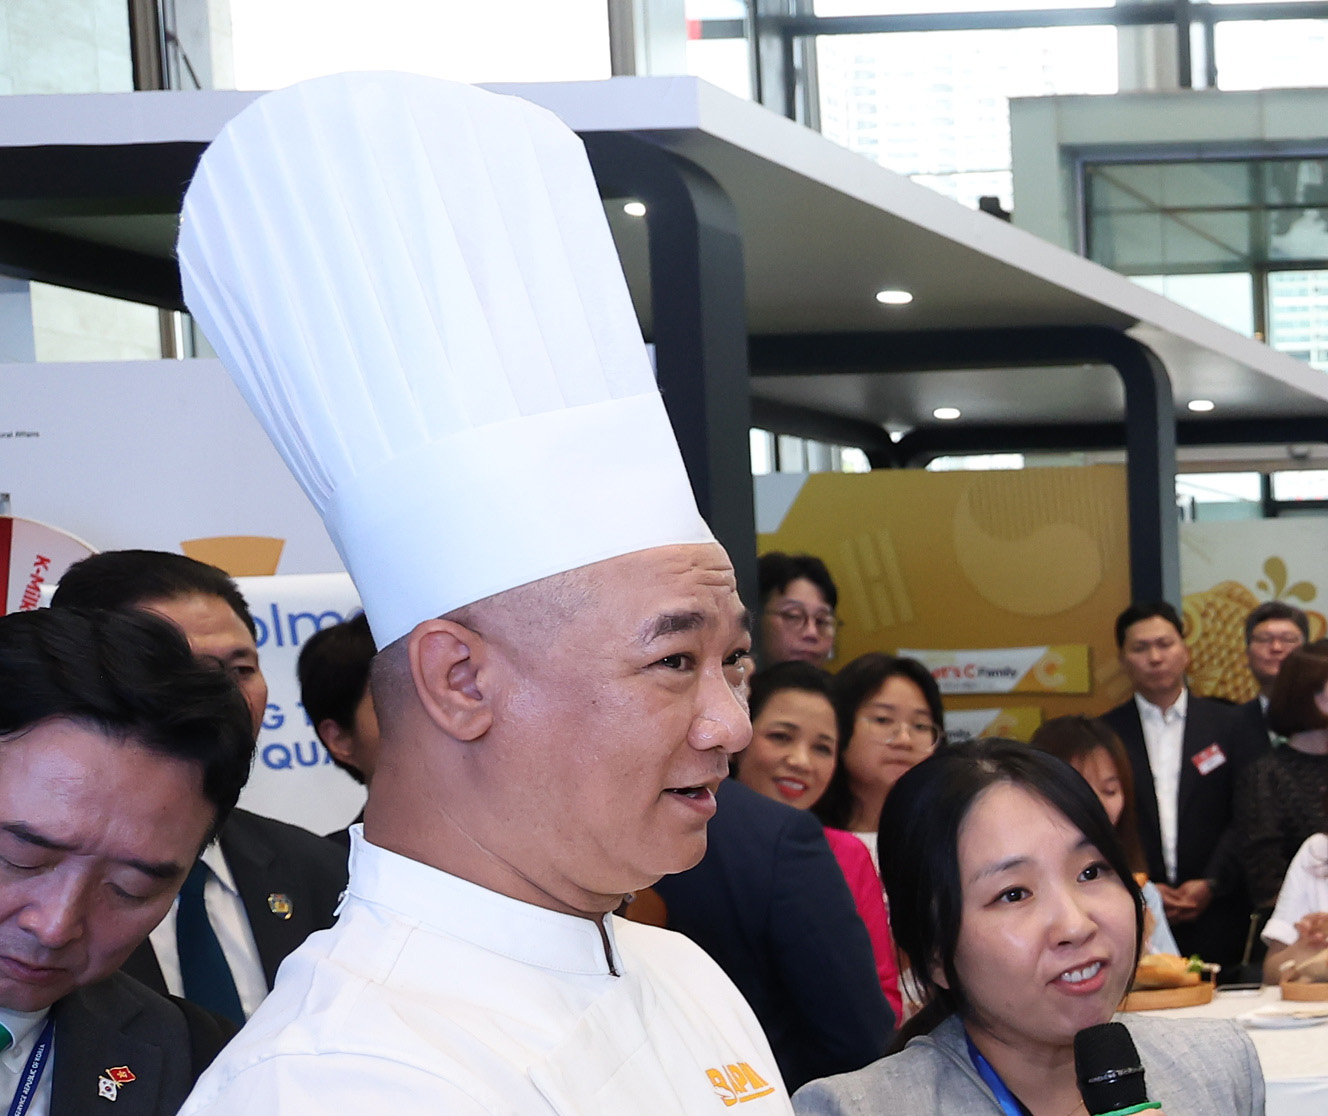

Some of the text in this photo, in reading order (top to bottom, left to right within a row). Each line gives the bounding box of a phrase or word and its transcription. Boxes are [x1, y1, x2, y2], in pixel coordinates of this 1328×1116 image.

[19, 555, 51, 611] K-Milk
[262, 741, 333, 770] QU
[22, 1069, 37, 1095] REPUBLIC
[31, 1060, 39, 1070] OF
